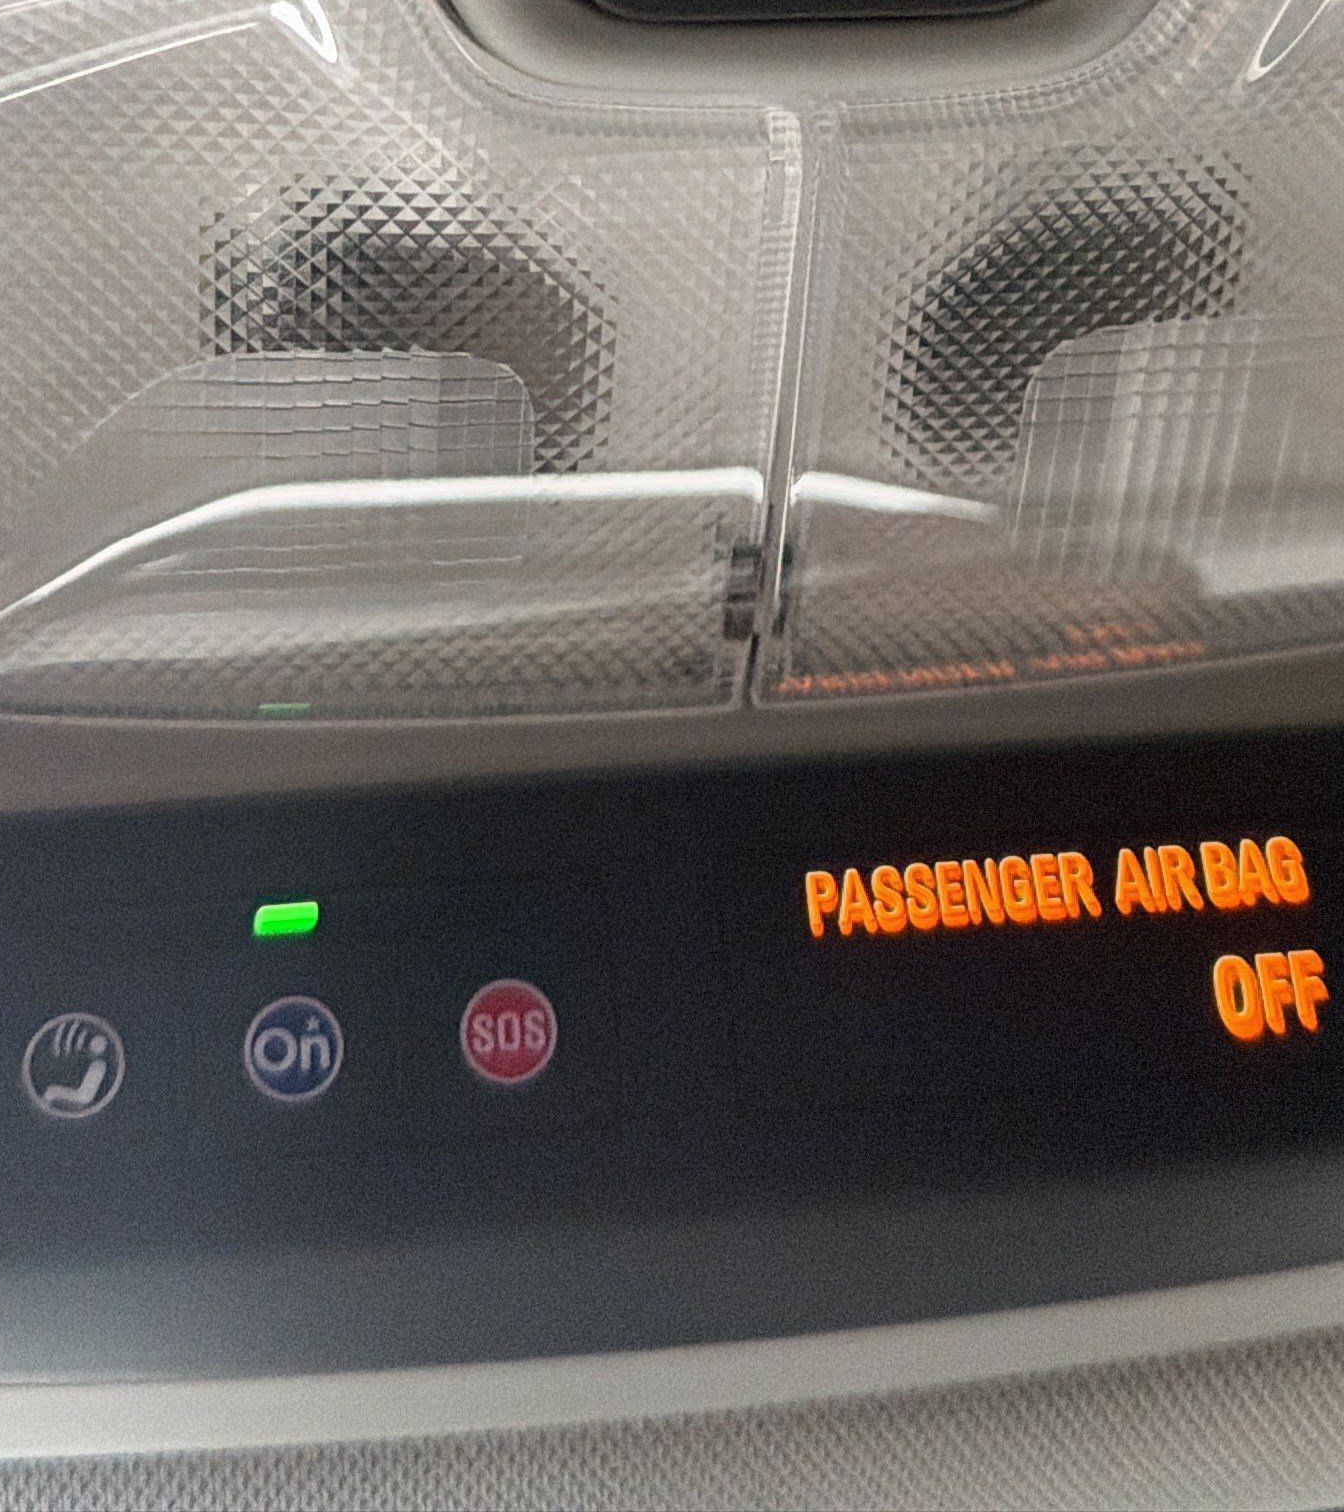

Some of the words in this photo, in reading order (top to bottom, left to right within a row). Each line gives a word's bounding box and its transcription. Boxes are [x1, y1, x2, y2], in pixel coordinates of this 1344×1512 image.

[805, 851, 1103, 938] PASSENGER
[472, 1012, 548, 1055] SOS
[1213, 949, 1330, 1041] OFF
